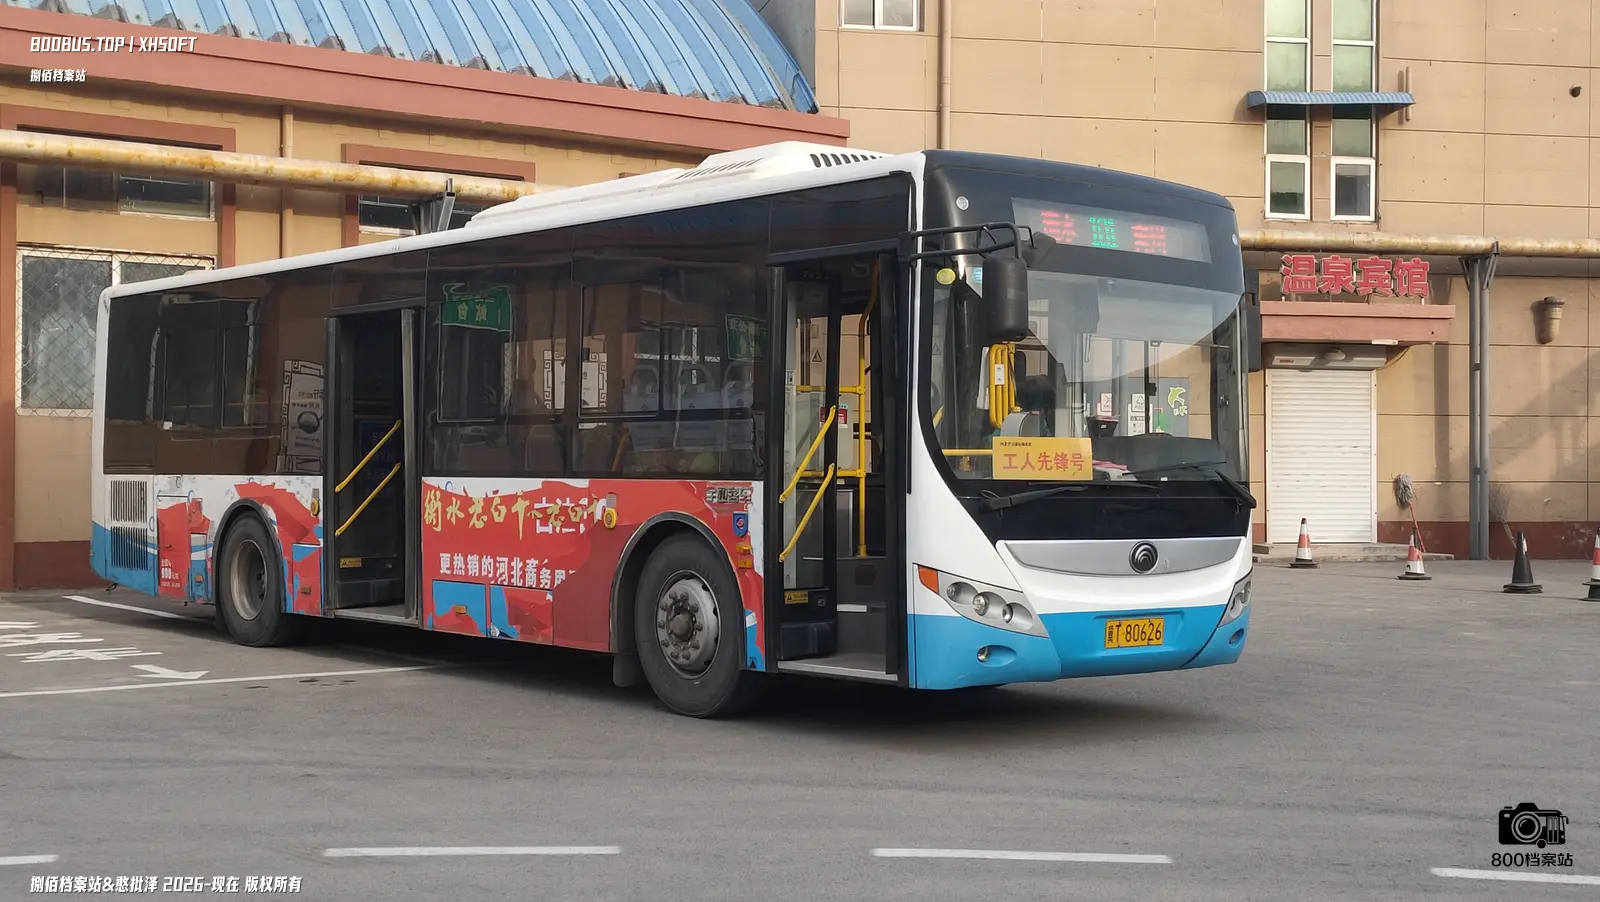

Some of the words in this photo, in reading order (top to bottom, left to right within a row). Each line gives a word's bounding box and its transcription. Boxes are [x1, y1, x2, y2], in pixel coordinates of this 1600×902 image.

[1280, 255, 1430, 297] 温泉宾馆
[1003, 452, 1084, 472] 工人先锋号
[439, 552, 576, 590] 更热销的河北商务用
